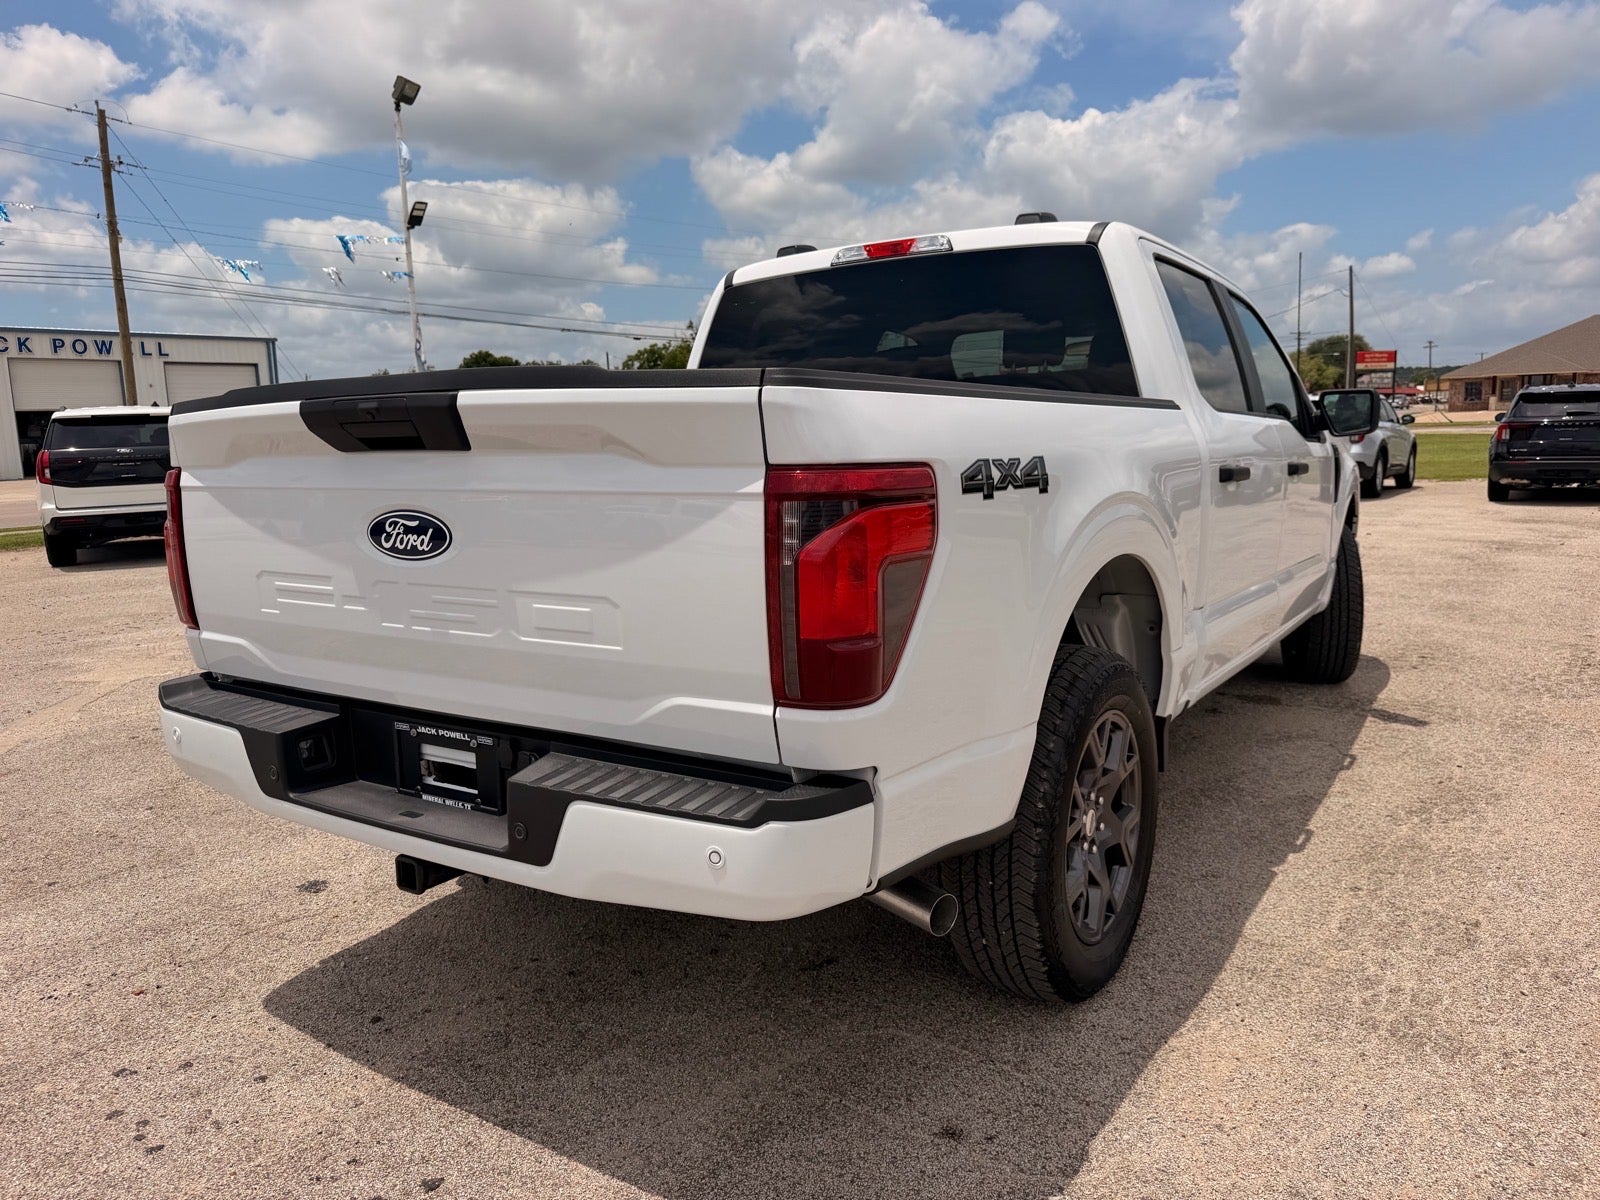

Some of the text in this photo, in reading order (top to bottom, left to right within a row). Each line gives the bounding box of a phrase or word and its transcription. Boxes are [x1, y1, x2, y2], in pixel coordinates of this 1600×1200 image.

[52, 338, 169, 356] POWLL
[960, 456, 1049, 500] 4X4
[381, 517, 433, 551] Ford
[416, 726, 437, 736] JACK
[438, 729, 471, 741] POWELL
